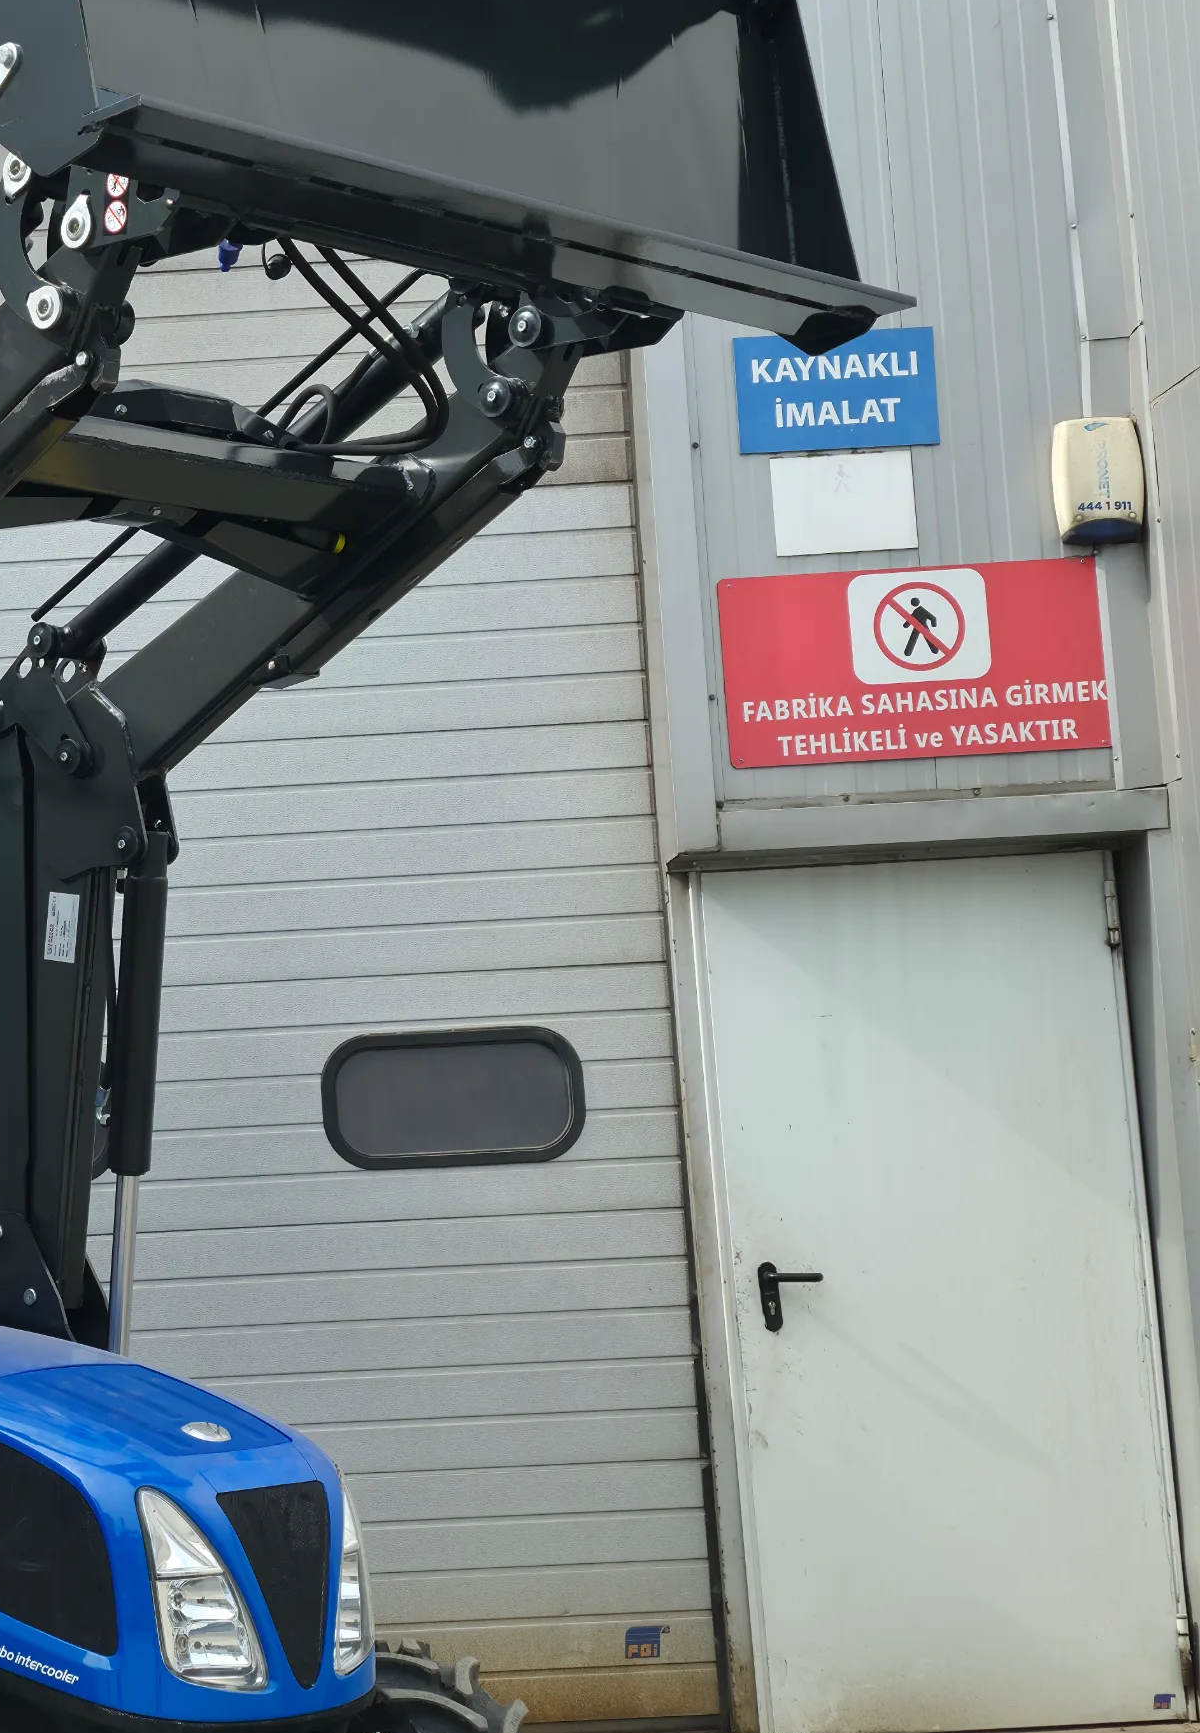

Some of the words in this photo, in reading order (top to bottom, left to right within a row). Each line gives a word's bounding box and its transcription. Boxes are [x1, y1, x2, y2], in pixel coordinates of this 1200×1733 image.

[751, 350, 919, 384] KAYNAKLI
[775, 397, 901, 428] İMALAT
[1077, 501, 1103, 512] 444
[1106, 501, 1111, 511] 1
[1114, 500, 1132, 511] 911
[743, 691, 854, 723] FABRİKA
[861, 685, 998, 716] SAHASINA
[1006, 678, 1109, 707] GİRMEK
[778, 724, 908, 757] TEHLİKELİ
[914, 730, 943, 749] ve
[950, 718, 1079, 747] YASAKTIR
[14, 1651, 80, 1685] intercooler
